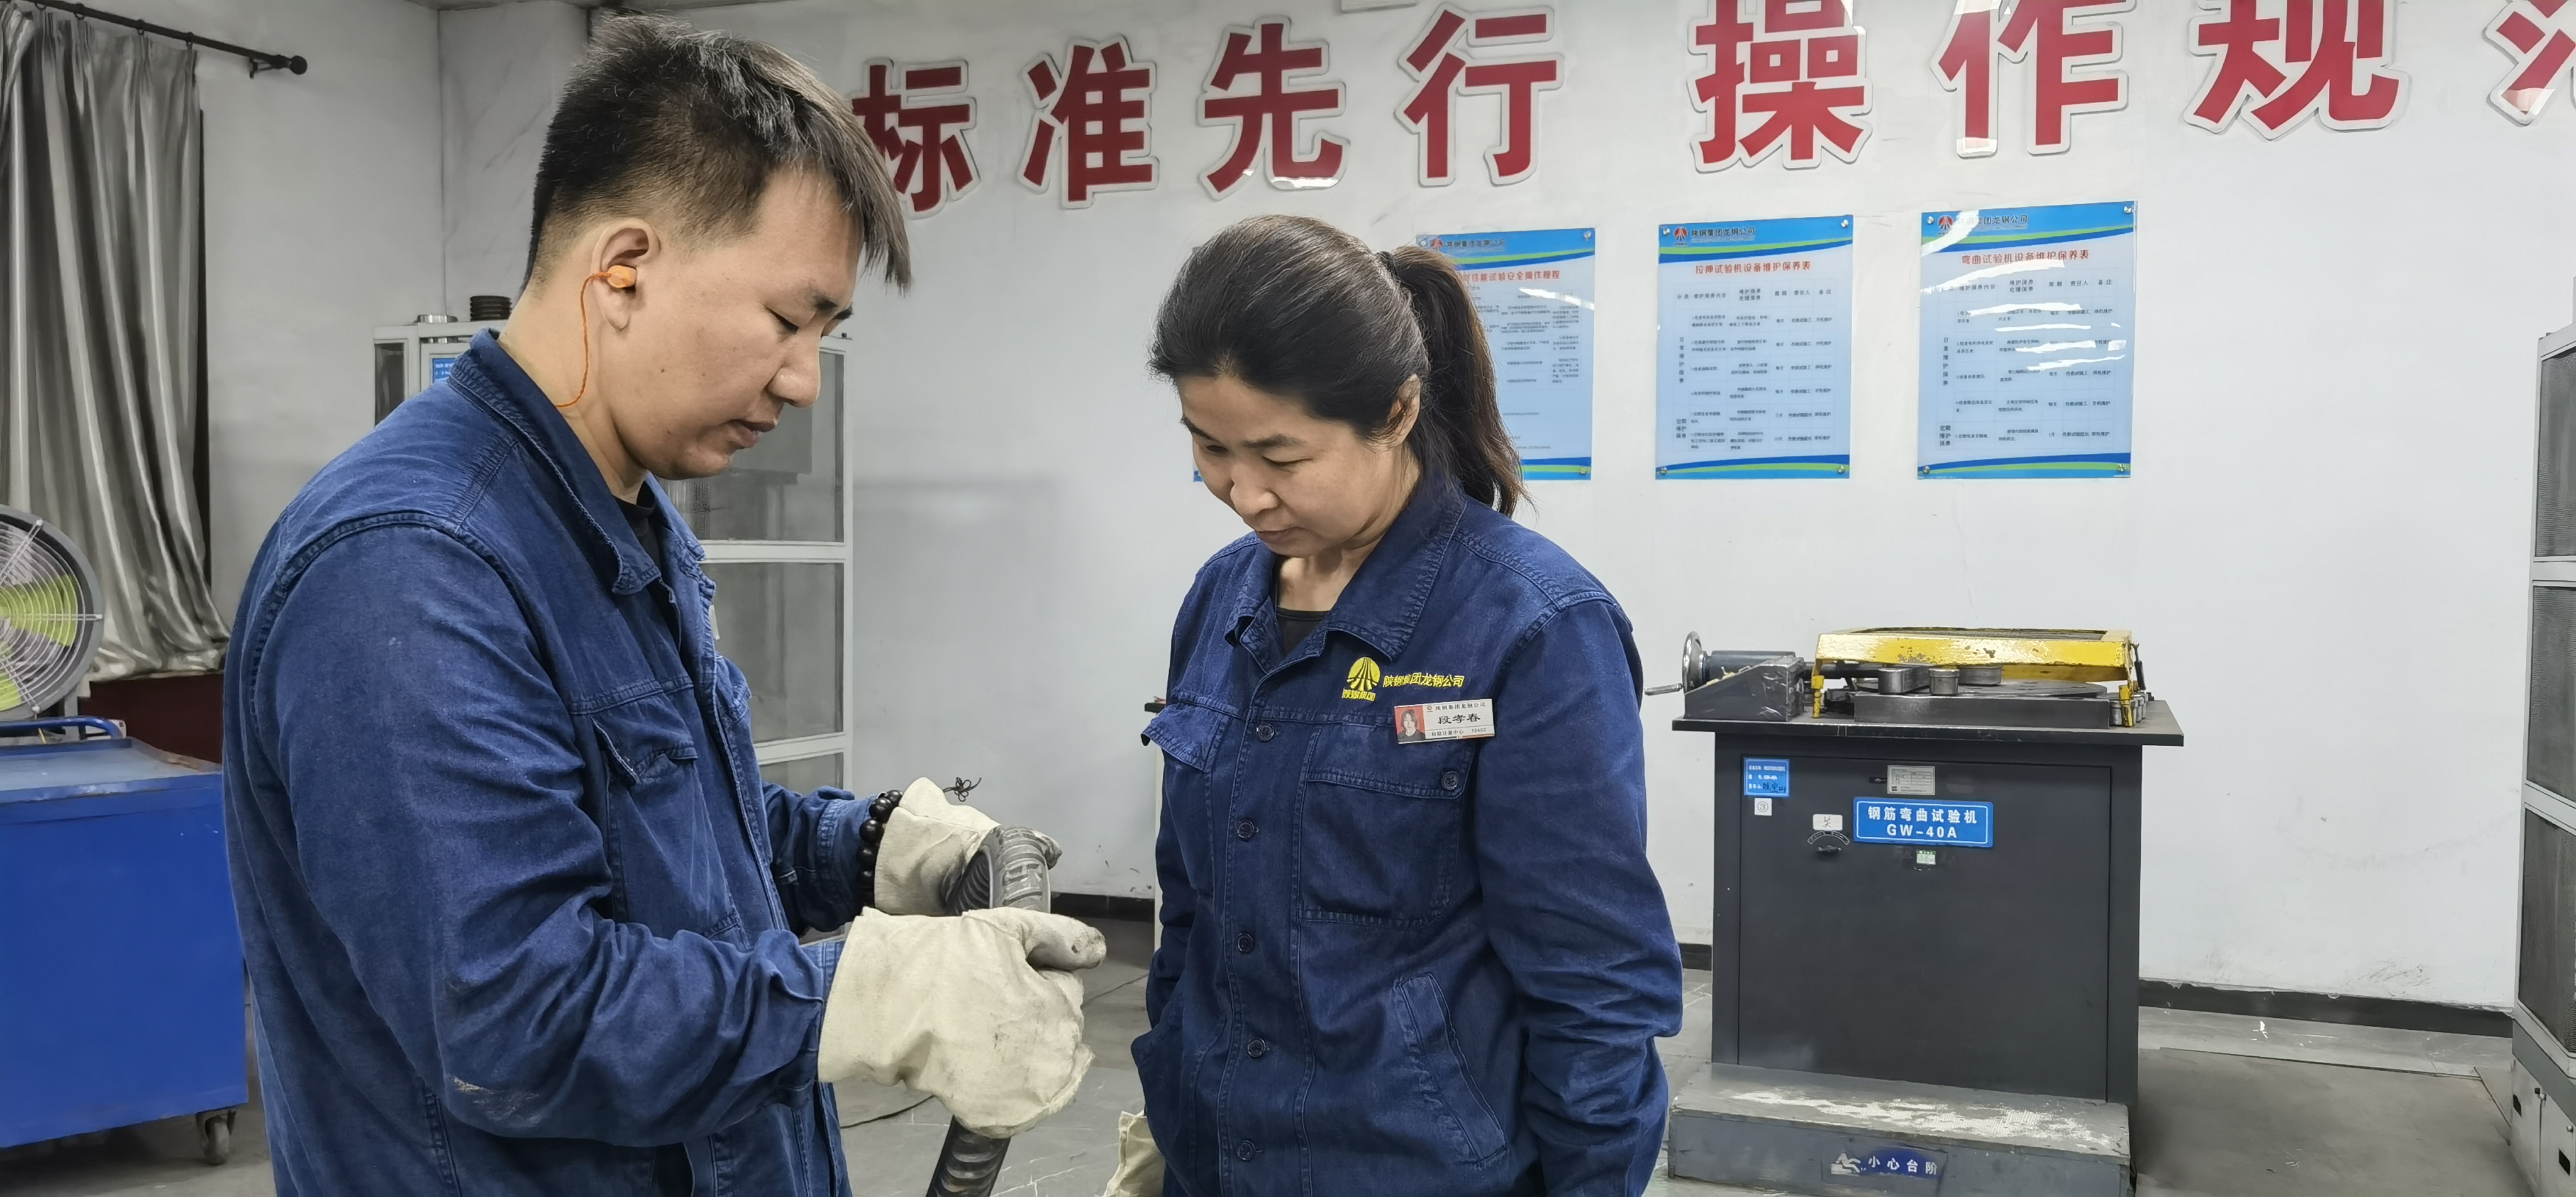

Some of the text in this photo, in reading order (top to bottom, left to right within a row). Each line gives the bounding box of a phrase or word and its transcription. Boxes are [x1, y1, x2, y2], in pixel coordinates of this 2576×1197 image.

[852, 0, 2576, 212] 标准先行 操作规
[1962, 249, 2089, 265] 弯曲试验机设备维护保养表
[1696, 261, 1811, 275] 拉伸试验机设备维护保养表
[1438, 714, 1480, 724] 段孝春
[1868, 805, 1977, 824] 钢筋弯曲试验机
[1887, 824, 1957, 839] GW-40A
[1868, 1156, 1938, 1175] 小心台阶
